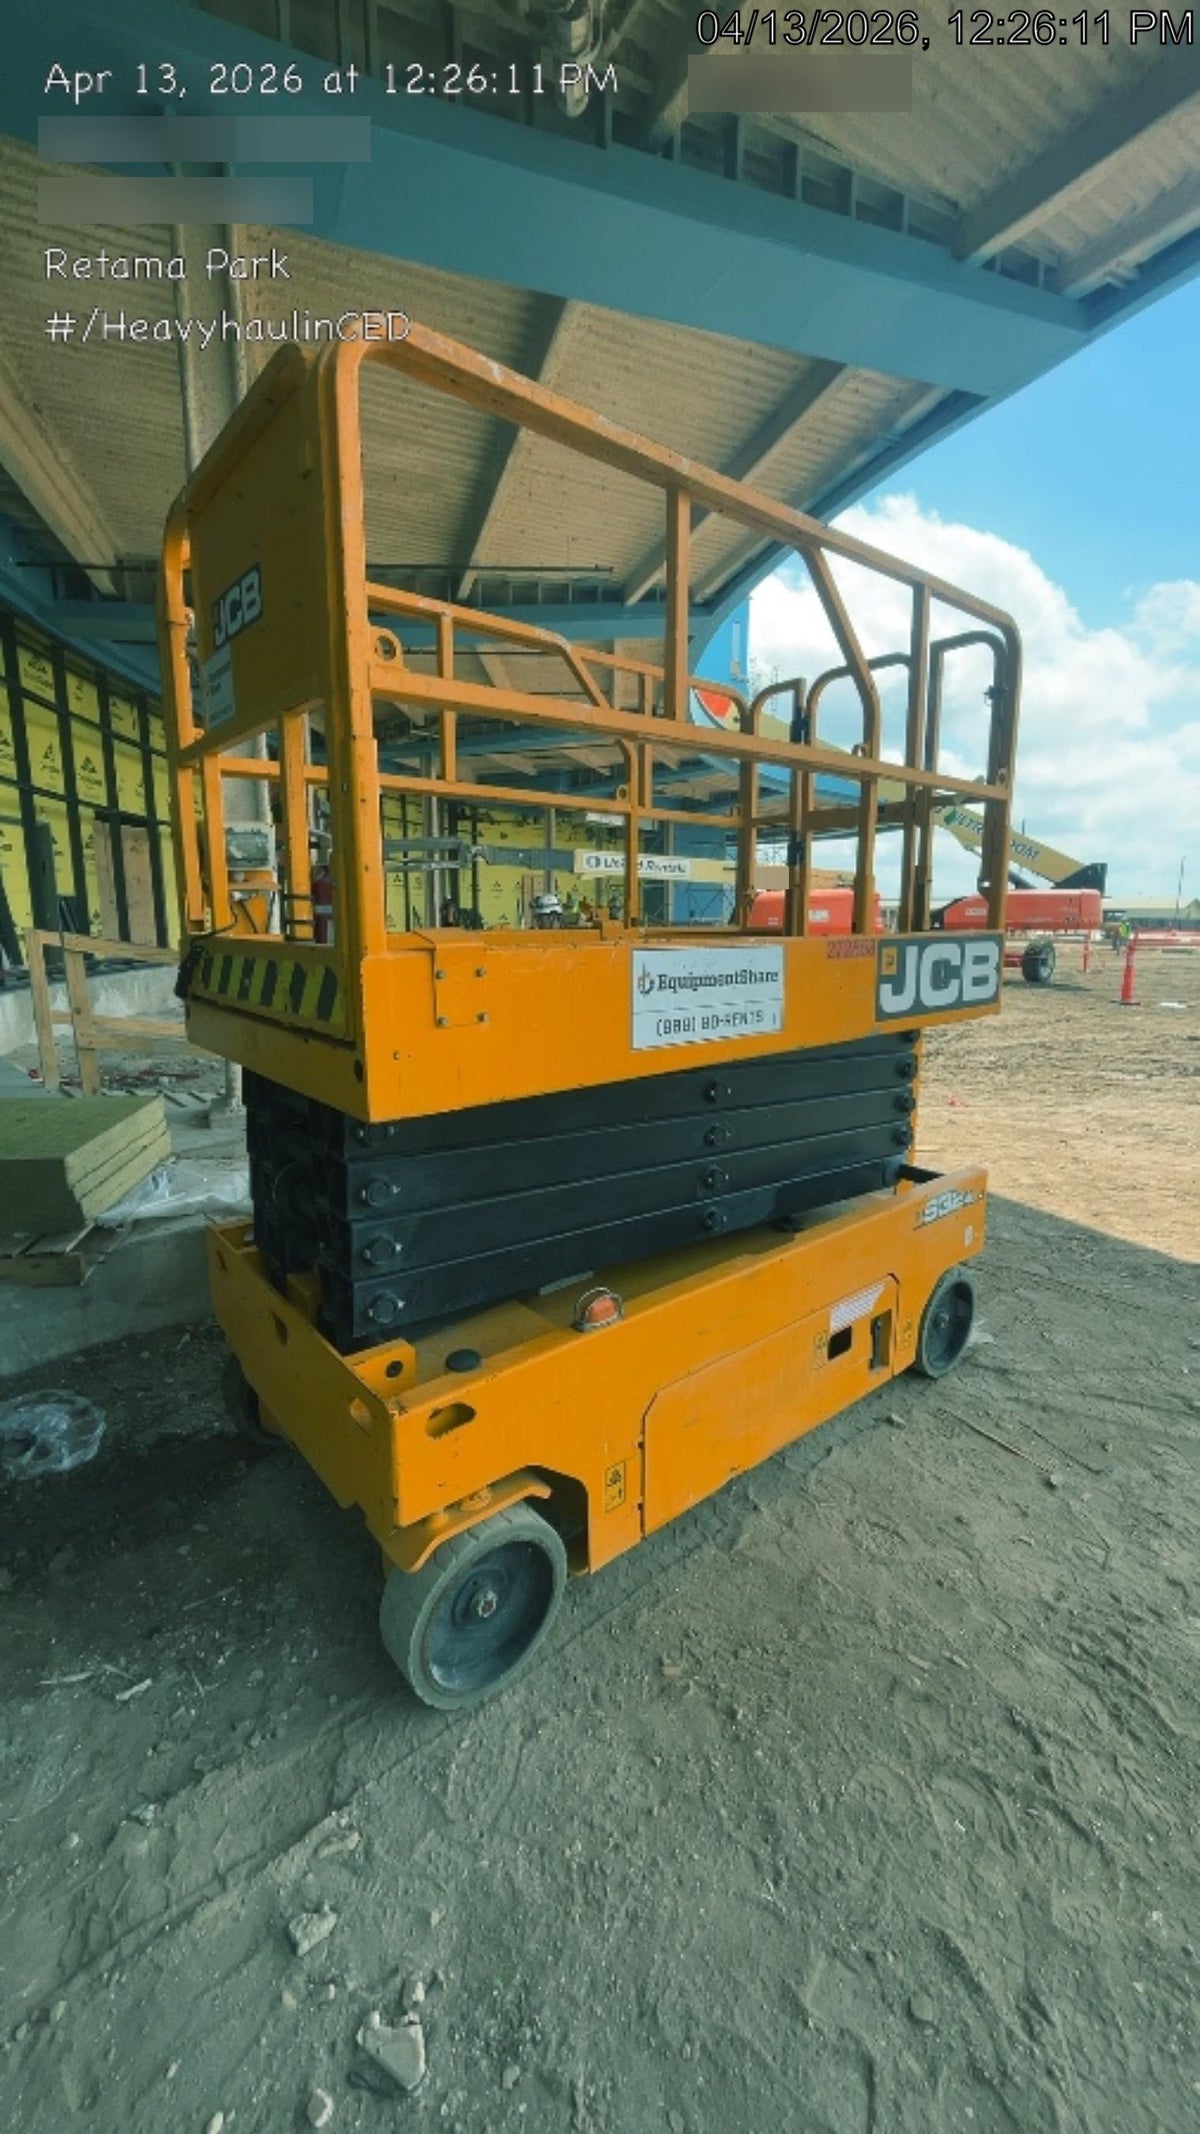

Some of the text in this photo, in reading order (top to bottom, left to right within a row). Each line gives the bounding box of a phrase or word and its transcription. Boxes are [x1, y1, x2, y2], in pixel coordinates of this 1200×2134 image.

[214, 569, 262, 647] JCB
[656, 969, 780, 994] EquipmentShare
[879, 941, 999, 1013] JCB
